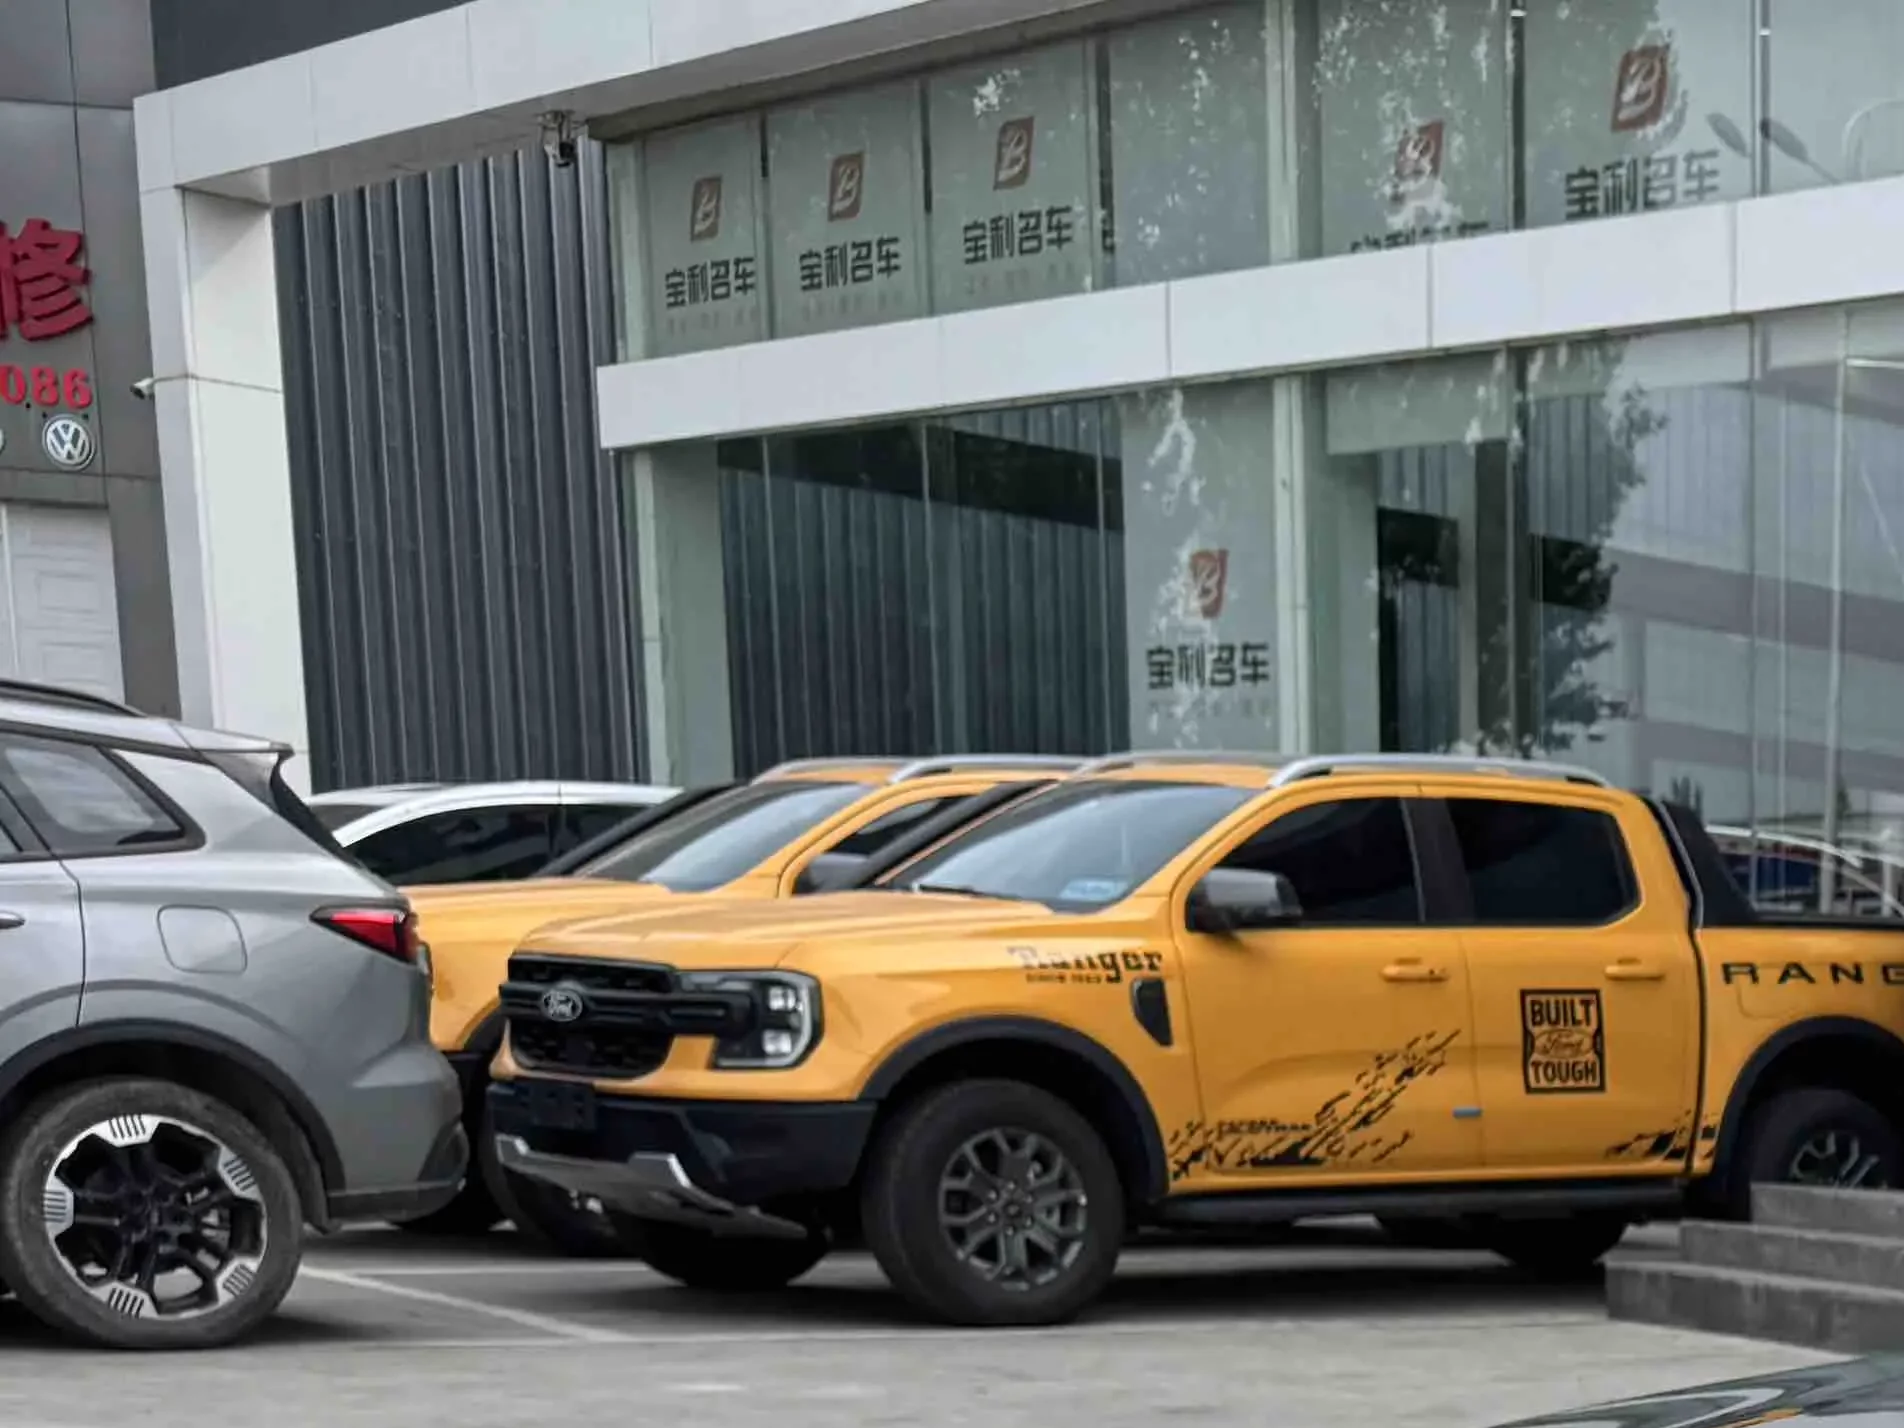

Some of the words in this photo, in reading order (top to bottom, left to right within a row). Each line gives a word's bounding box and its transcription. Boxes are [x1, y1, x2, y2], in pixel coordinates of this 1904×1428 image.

[1565, 148, 1721, 221] 宝利名车
[963, 205, 1073, 265] 宝利名车
[0, 218, 93, 342] 修
[665, 256, 756, 309] 宝利名车
[799, 236, 901, 292] 宝利名车
[1146, 641, 1270, 690] 宝利名车
[1530, 999, 1595, 1026] BUILT
[1531, 1060, 1597, 1084] TOUGH
